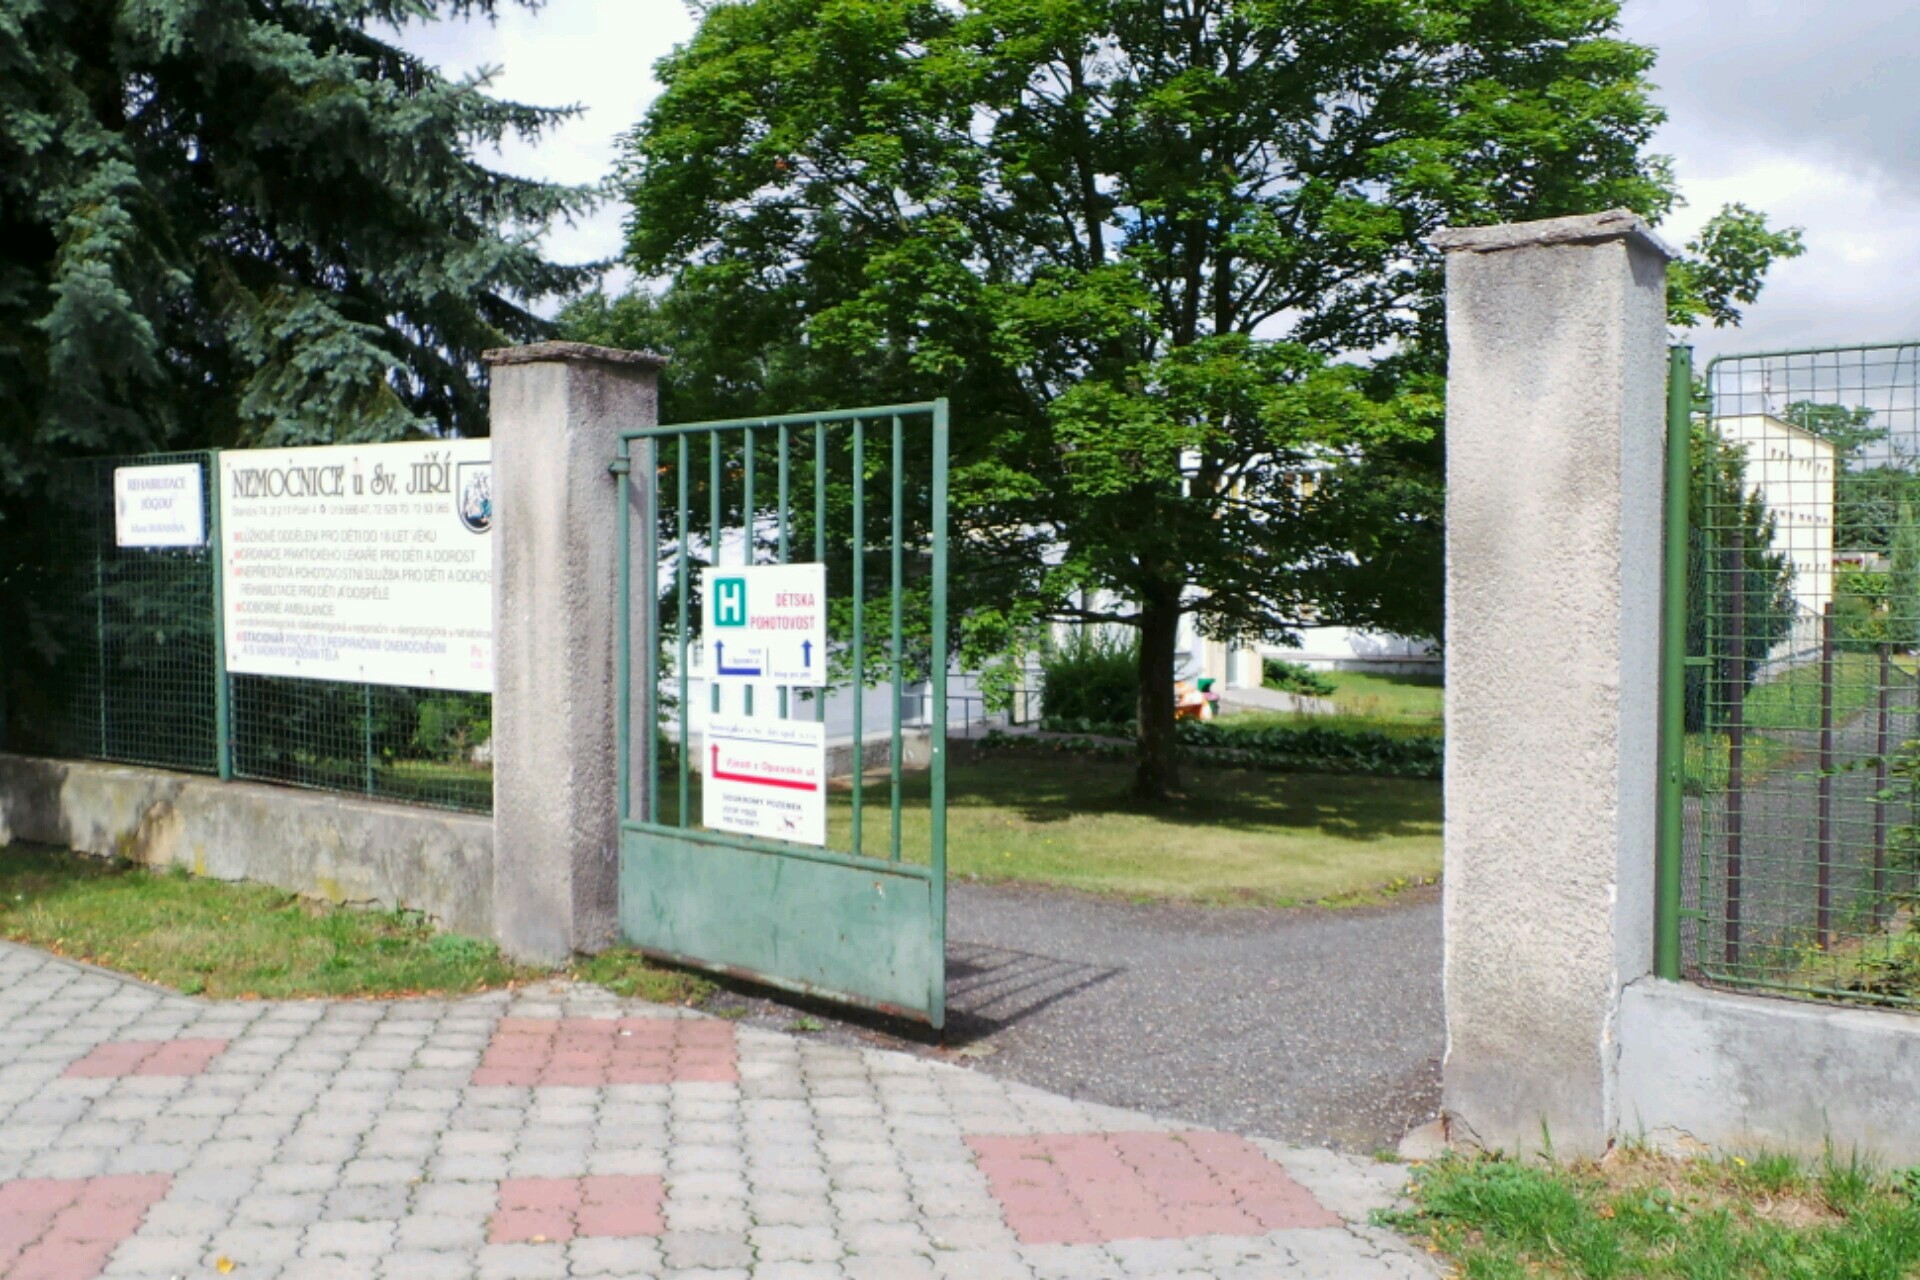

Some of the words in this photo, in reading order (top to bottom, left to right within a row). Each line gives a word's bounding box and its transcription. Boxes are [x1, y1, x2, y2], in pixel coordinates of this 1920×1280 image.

[231, 464, 344, 498] NEMOCNICE
[406, 451, 451, 494] JIŘÍ
[380, 549, 400, 562] PRO
[401, 568, 422, 582] PRO
[424, 565, 445, 582] DĚTI
[750, 615, 815, 630] POHOTOVOST
